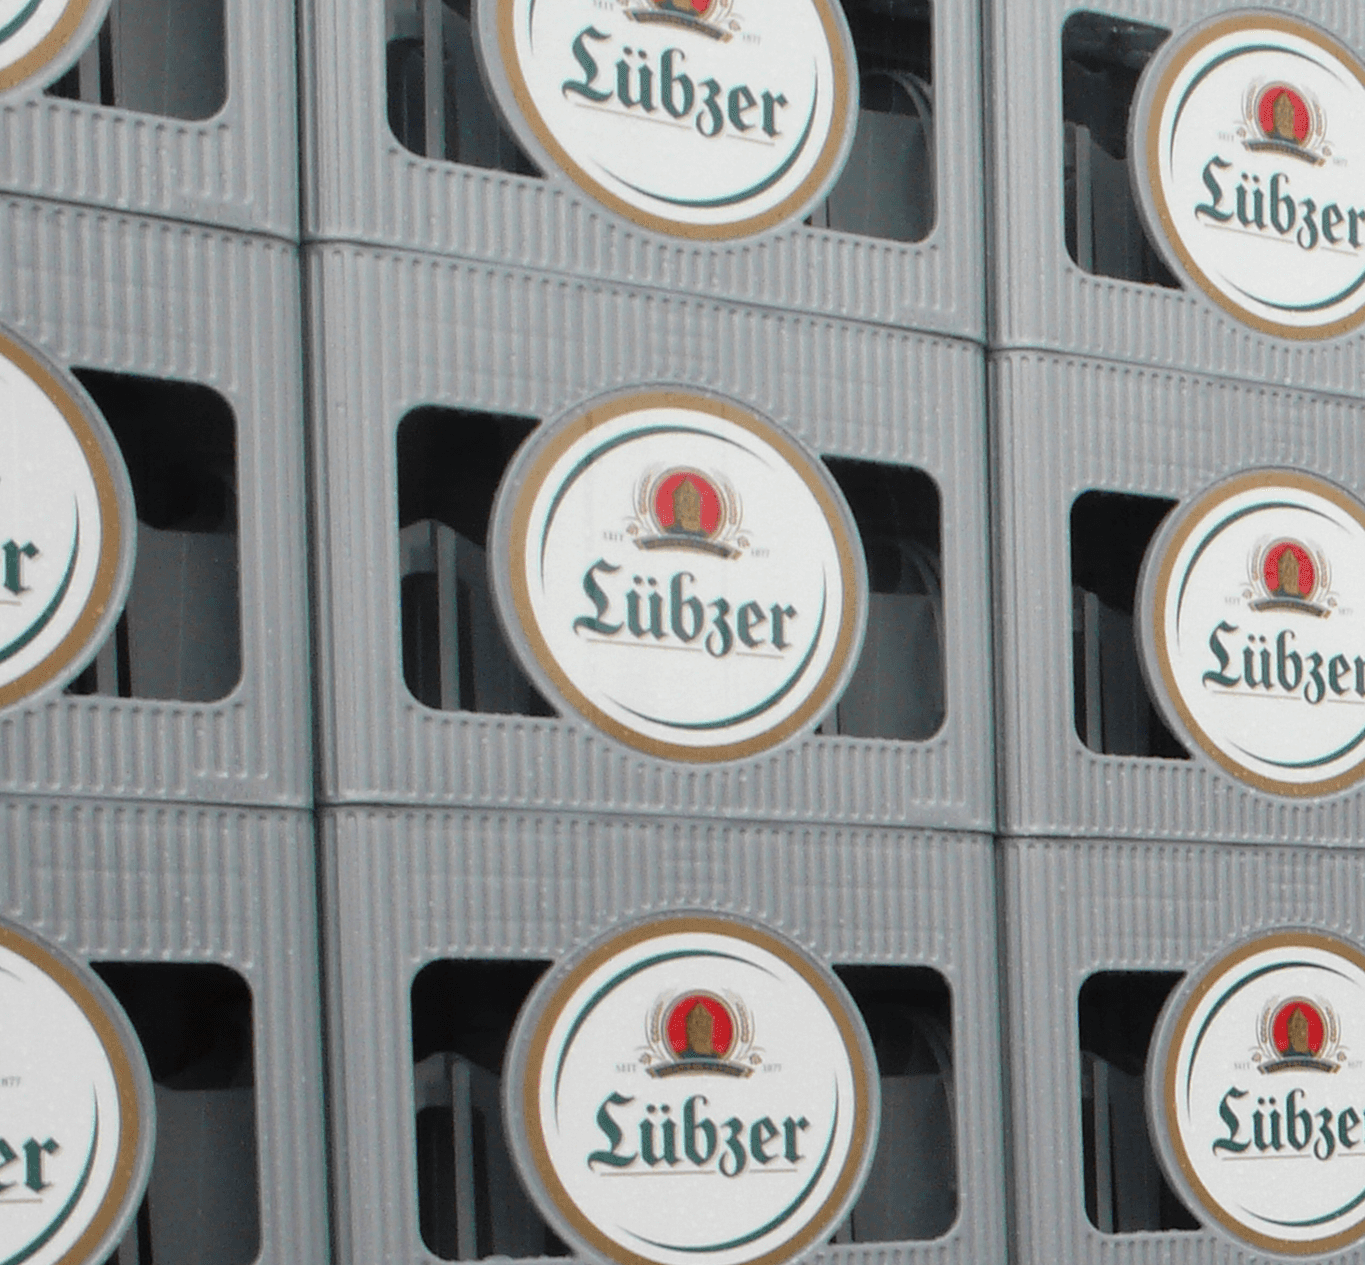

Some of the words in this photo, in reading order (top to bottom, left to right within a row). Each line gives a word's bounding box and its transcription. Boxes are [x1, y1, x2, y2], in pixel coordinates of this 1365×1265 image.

[561, 26, 788, 138] Lübzer
[573, 559, 796, 657] Lübzer
[587, 1092, 809, 1177] Lübzer
